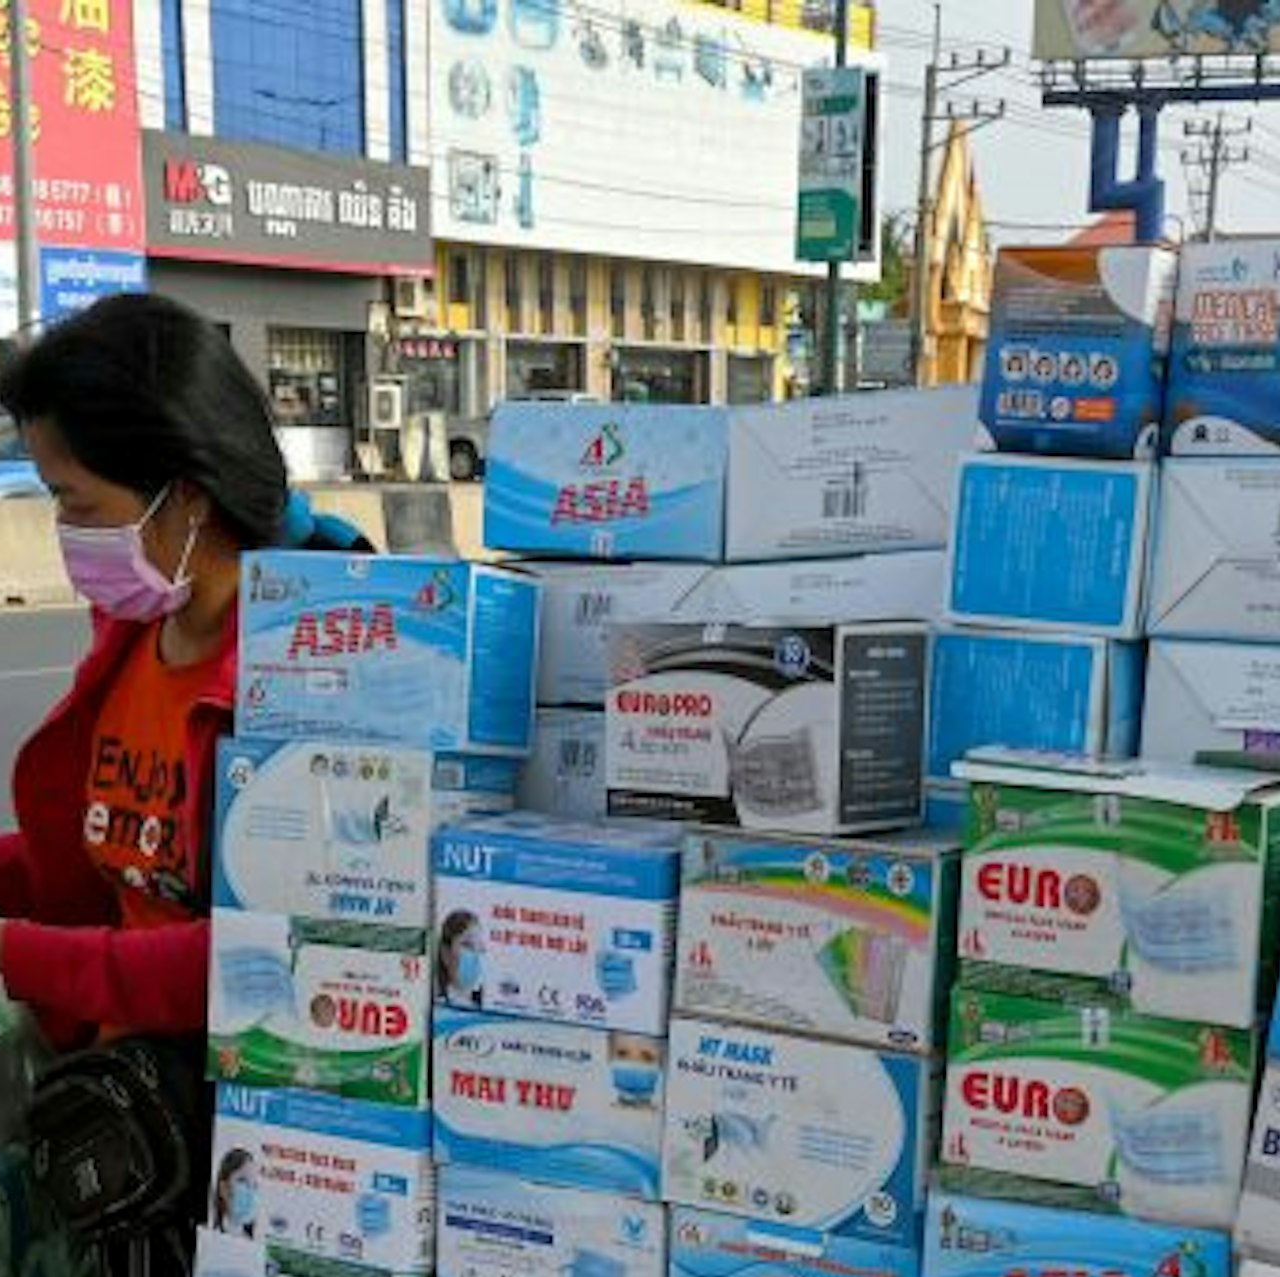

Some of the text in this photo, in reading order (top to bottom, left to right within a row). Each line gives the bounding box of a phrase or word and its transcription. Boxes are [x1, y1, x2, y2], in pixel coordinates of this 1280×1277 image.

[550, 475, 651, 527] ASIA
[287, 603, 398, 662] ASIA
[617, 690, 712, 718] EUROPRO
[443, 842, 496, 875] NUT
[977, 863, 1101, 915] EURO
[310, 994, 409, 1040] EURO
[724, 1041, 774, 1065] MASK
[451, 1069, 506, 1103] MAI
[962, 1072, 1091, 1126] EURO
